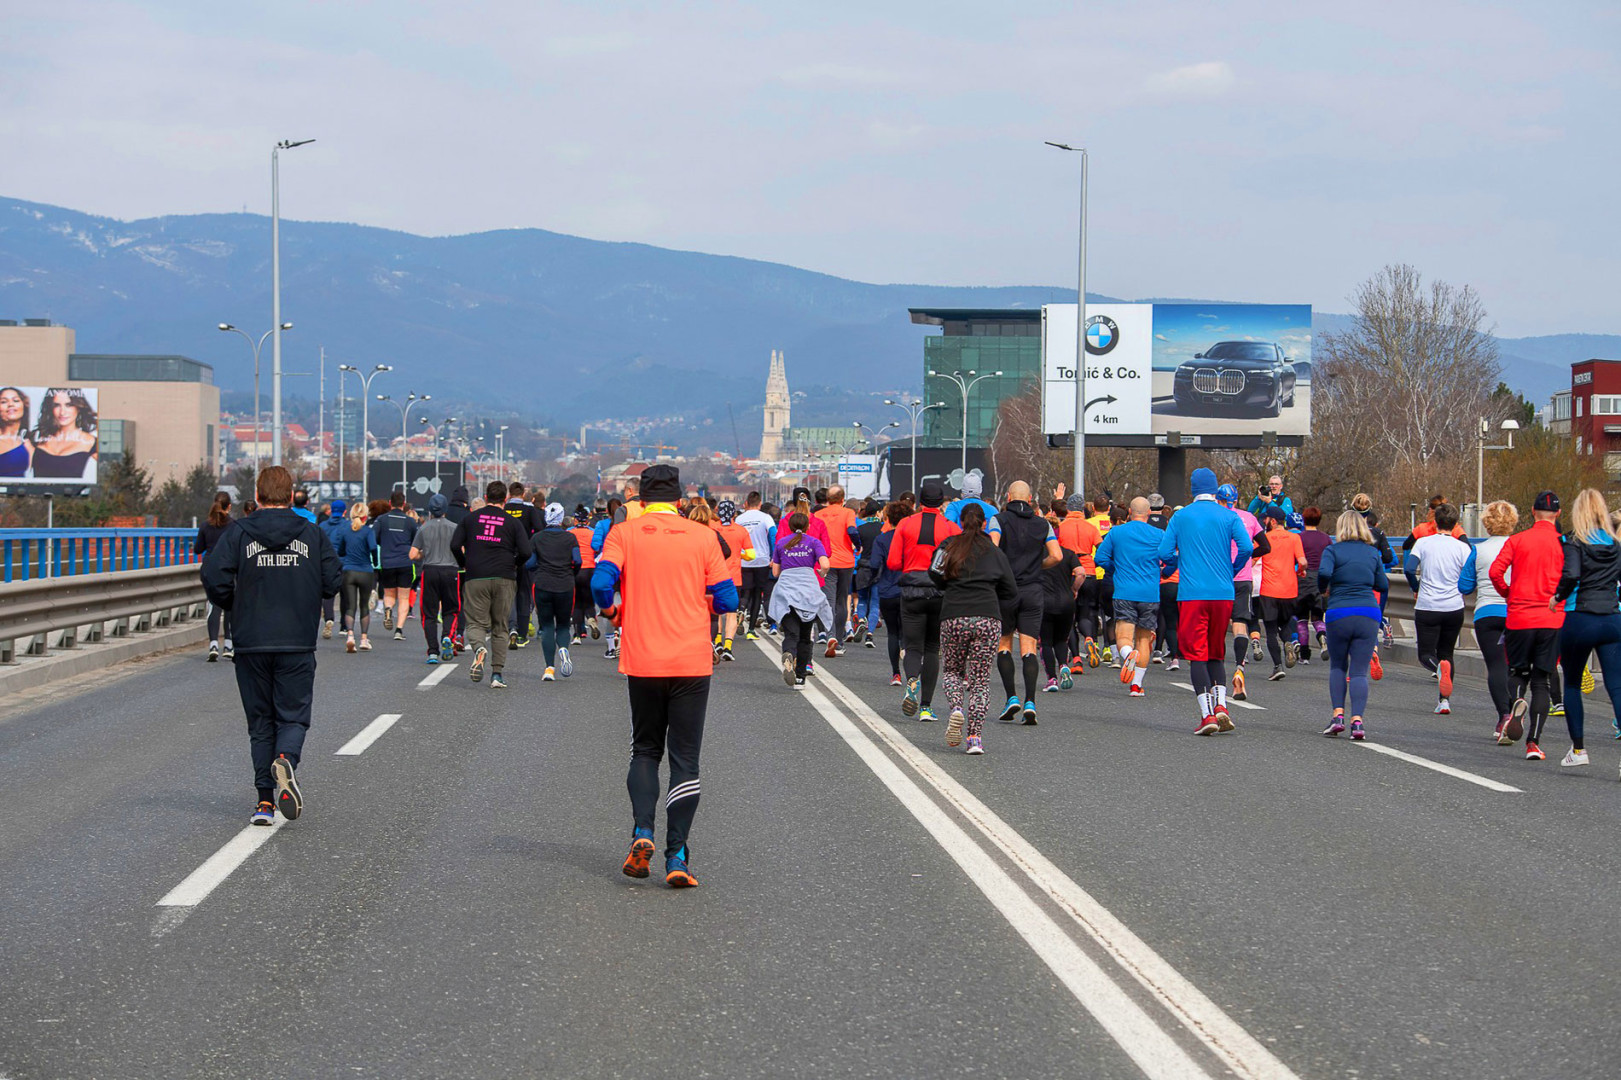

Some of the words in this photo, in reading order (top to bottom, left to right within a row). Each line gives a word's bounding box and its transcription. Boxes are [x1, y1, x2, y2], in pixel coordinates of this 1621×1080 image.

[1057, 366, 1099, 379] Toić
[1103, 366, 1113, 379] &
[1117, 366, 1141, 379] Co.
[1093, 415, 1100, 423] 4
[1102, 415, 1118, 424] km
[256, 554, 275, 567] ATH.
[276, 554, 300, 567] DEPT.
